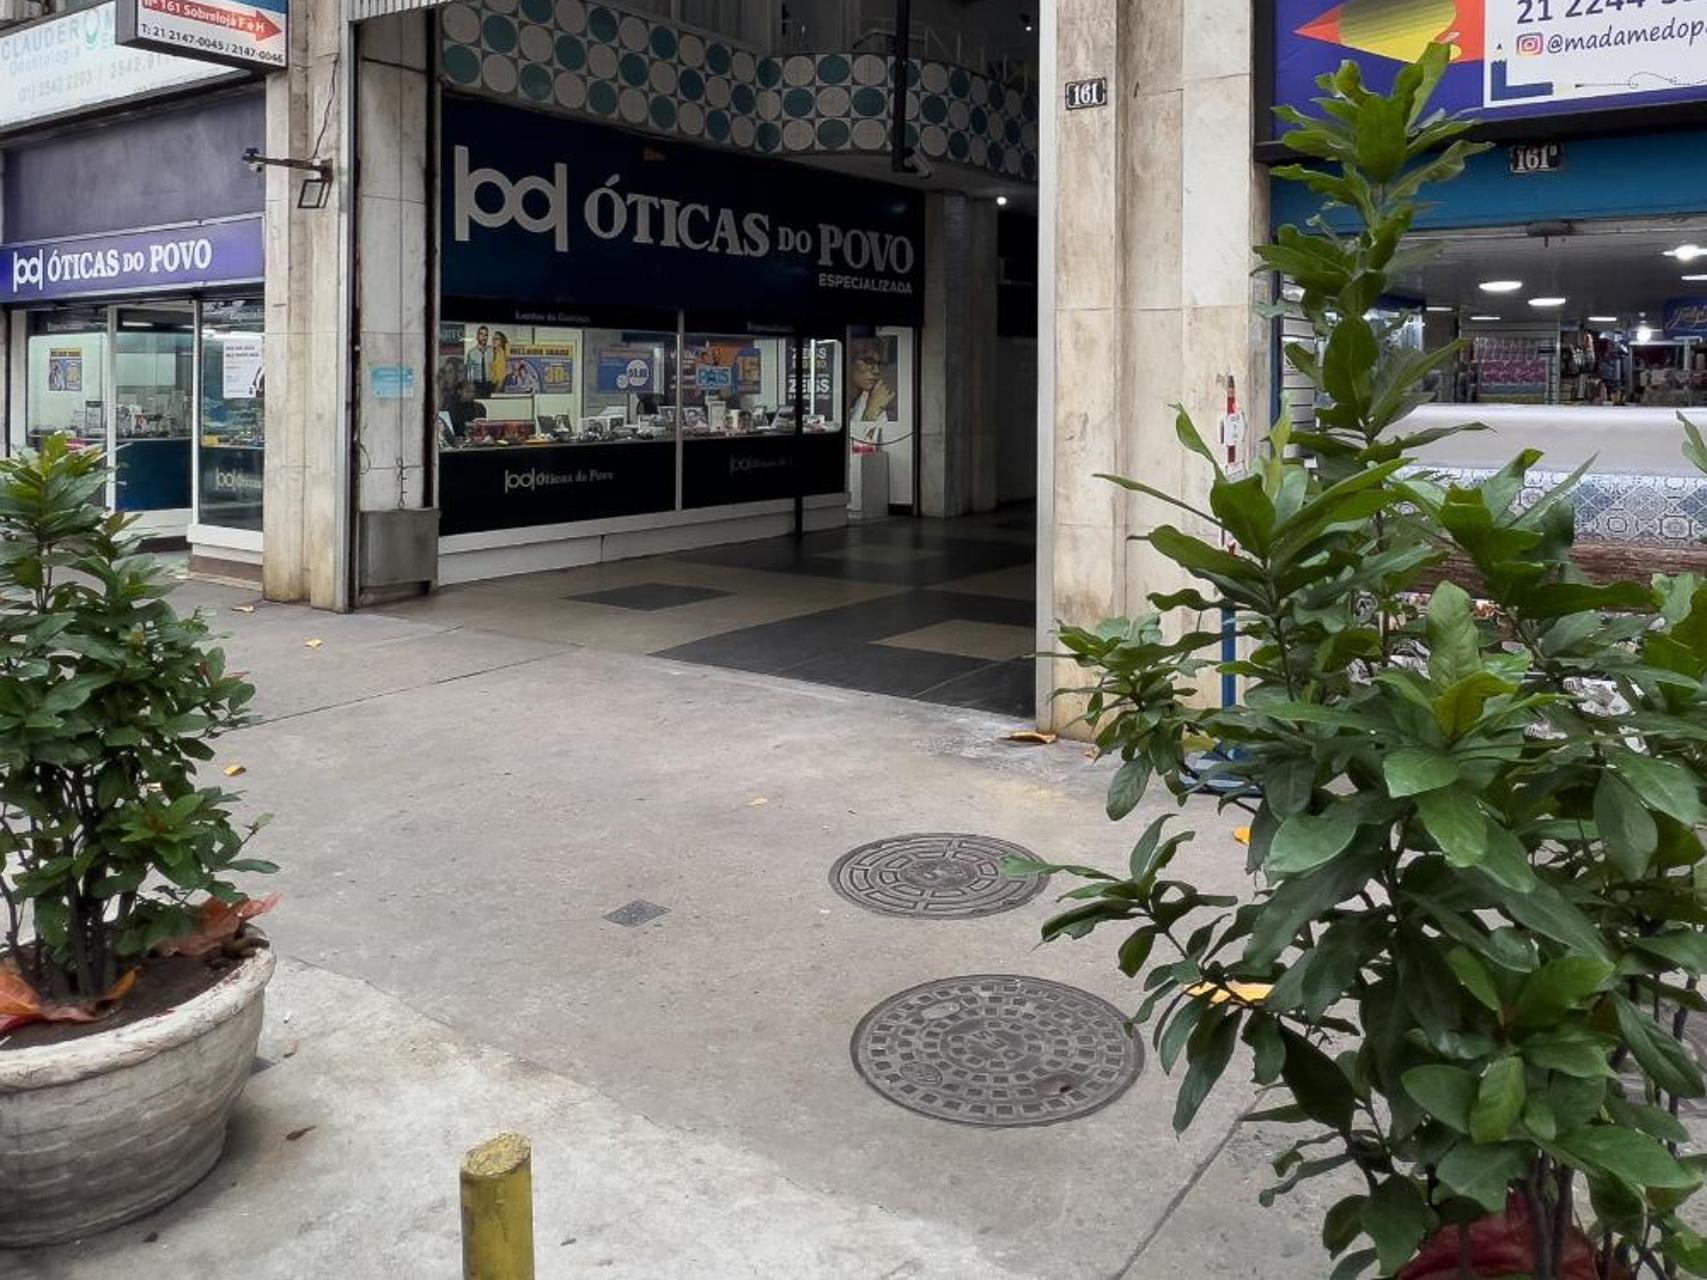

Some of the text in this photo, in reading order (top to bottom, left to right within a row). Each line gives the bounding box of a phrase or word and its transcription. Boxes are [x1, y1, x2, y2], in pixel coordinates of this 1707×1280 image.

[161, 0, 180, 12] 161
[153, 26, 165, 37] 21
[1547, 16, 1707, 54] @madamedop
[1073, 83, 1098, 105] 161
[584, 174, 770, 257] ÓTICAS
[777, 225, 812, 253] DO
[817, 222, 914, 274] POVO
[47, 249, 119, 282] ÓTICAS
[123, 252, 144, 272] DO
[150, 239, 212, 272] POVO
[819, 273, 912, 294] ESPECIALIZADA
